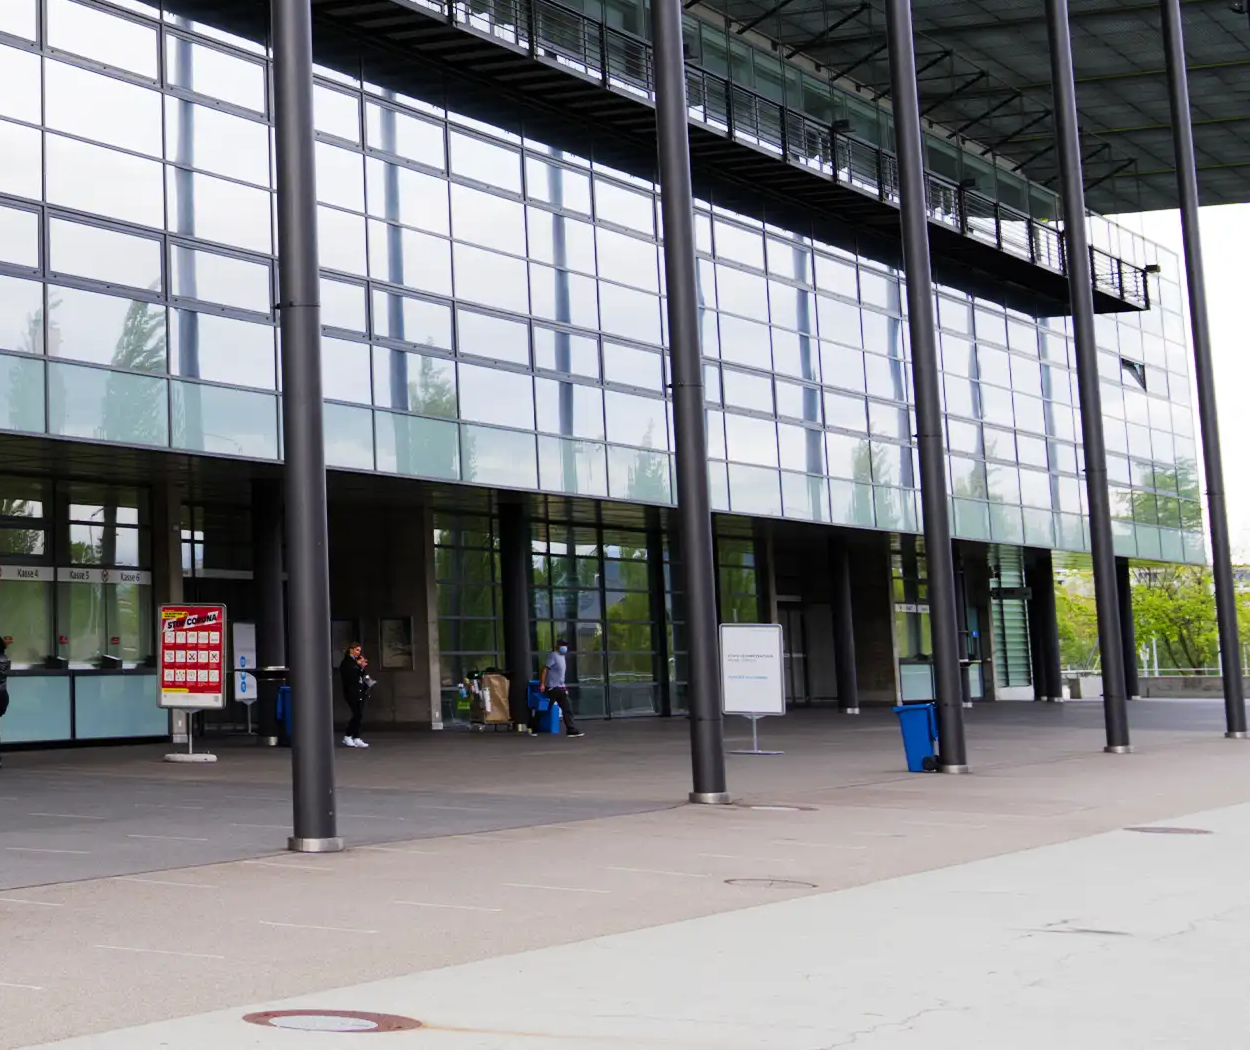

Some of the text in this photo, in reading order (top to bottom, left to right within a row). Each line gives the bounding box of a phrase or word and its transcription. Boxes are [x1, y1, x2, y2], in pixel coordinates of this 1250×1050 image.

[17, 568, 34, 578] Kasse
[69, 570, 85, 580] Kasse
[120, 572, 135, 582] Kasse
